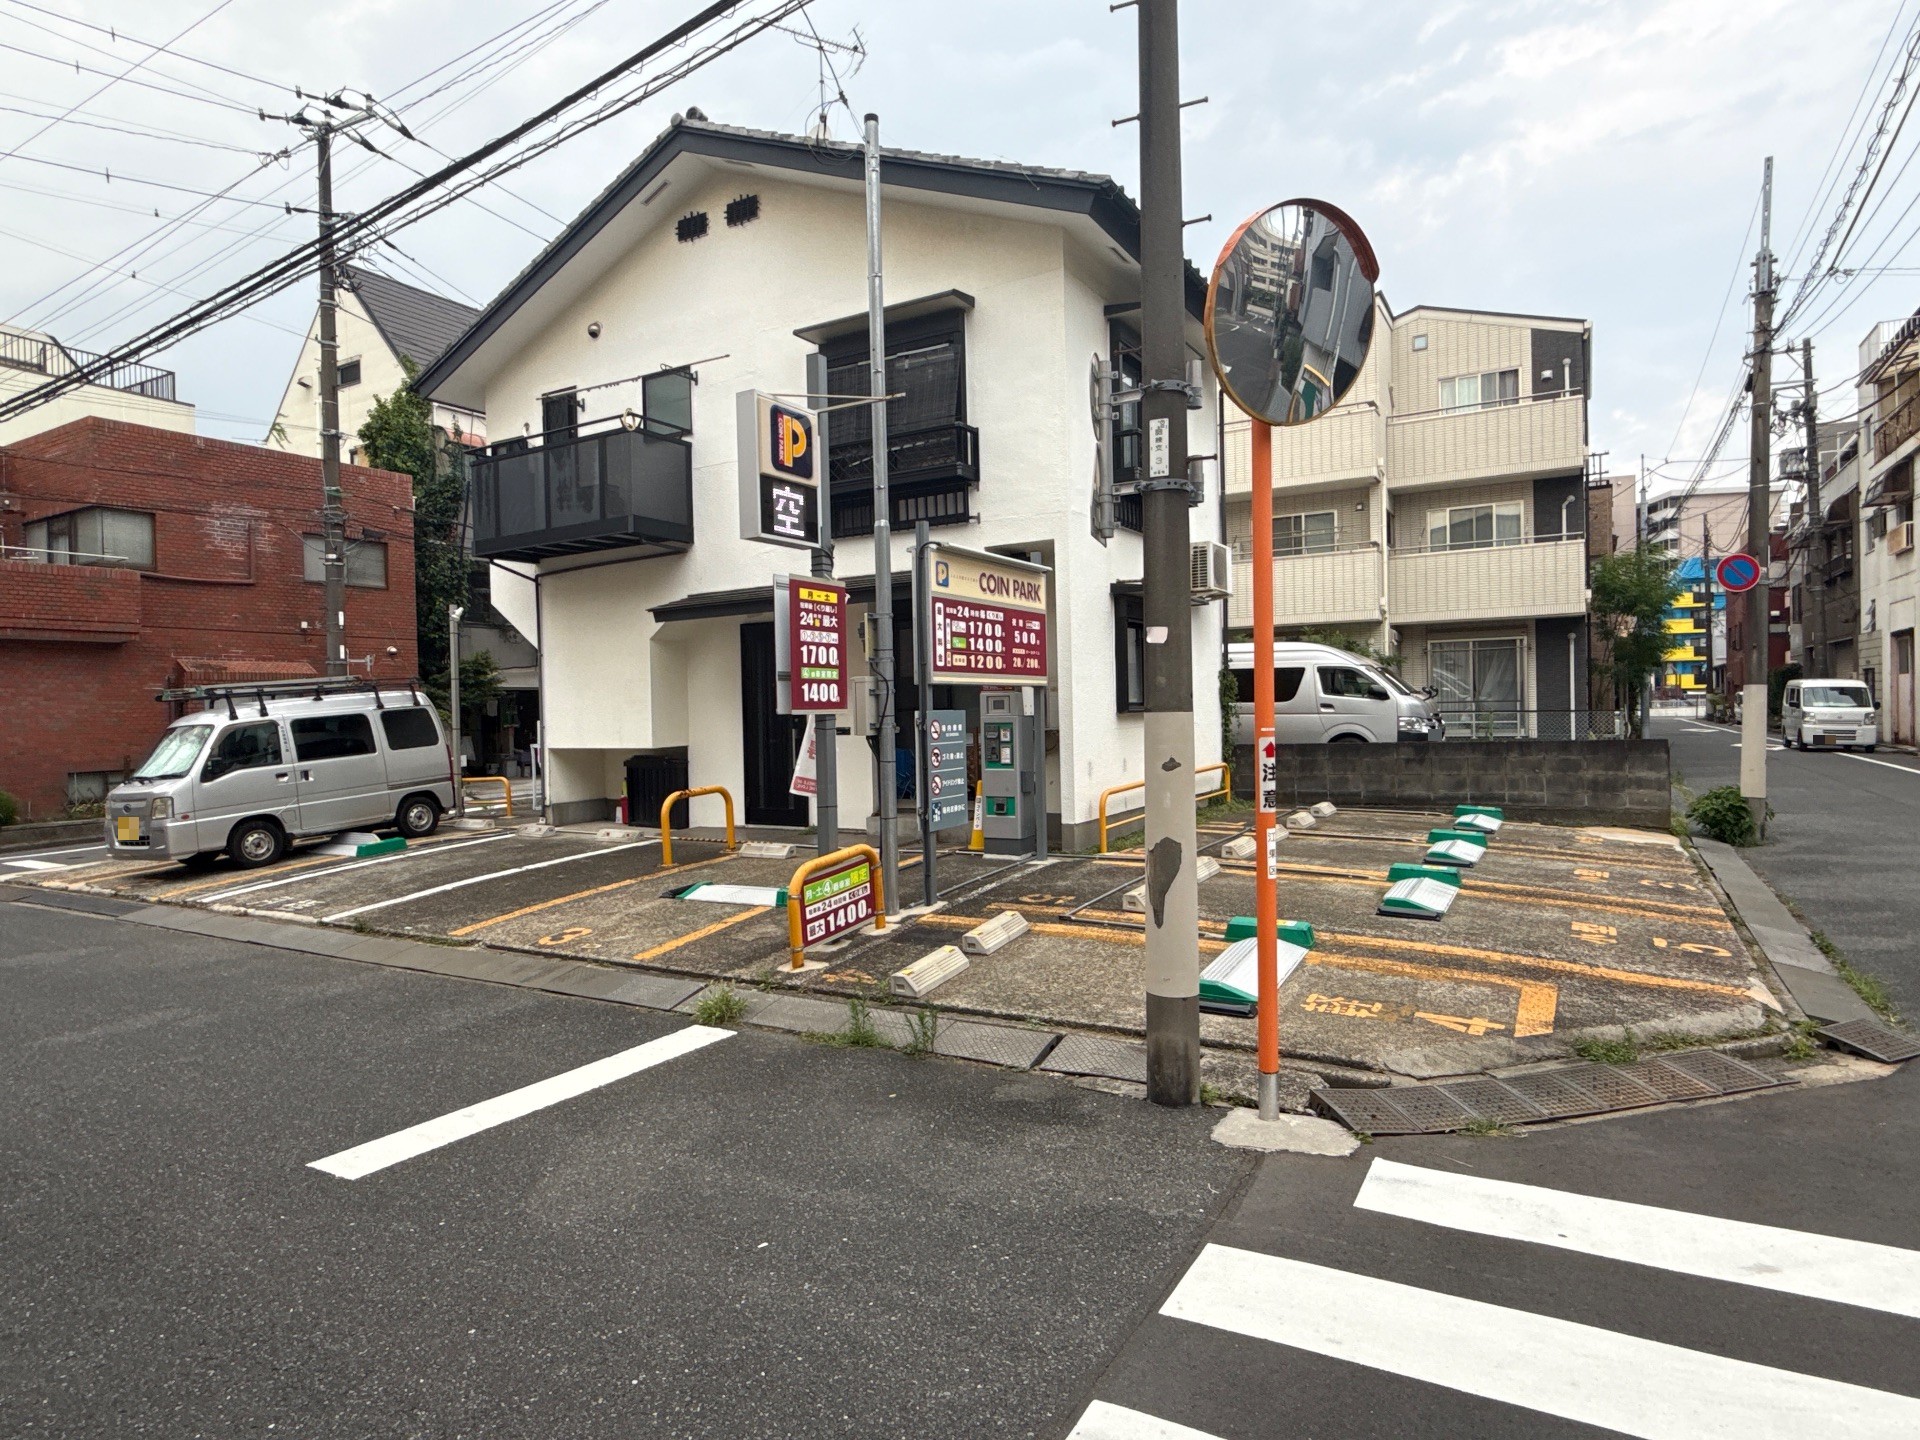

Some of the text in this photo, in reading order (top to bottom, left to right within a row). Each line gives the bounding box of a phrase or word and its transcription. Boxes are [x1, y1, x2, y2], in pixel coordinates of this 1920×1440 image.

[773, 486, 804, 537] 空
[979, 572, 1041, 602] COIN PARK
[1263, 763, 1276, 809] 注意
[809, 923, 824, 938] 最大
[1413, 1011, 1506, 1036] 4
